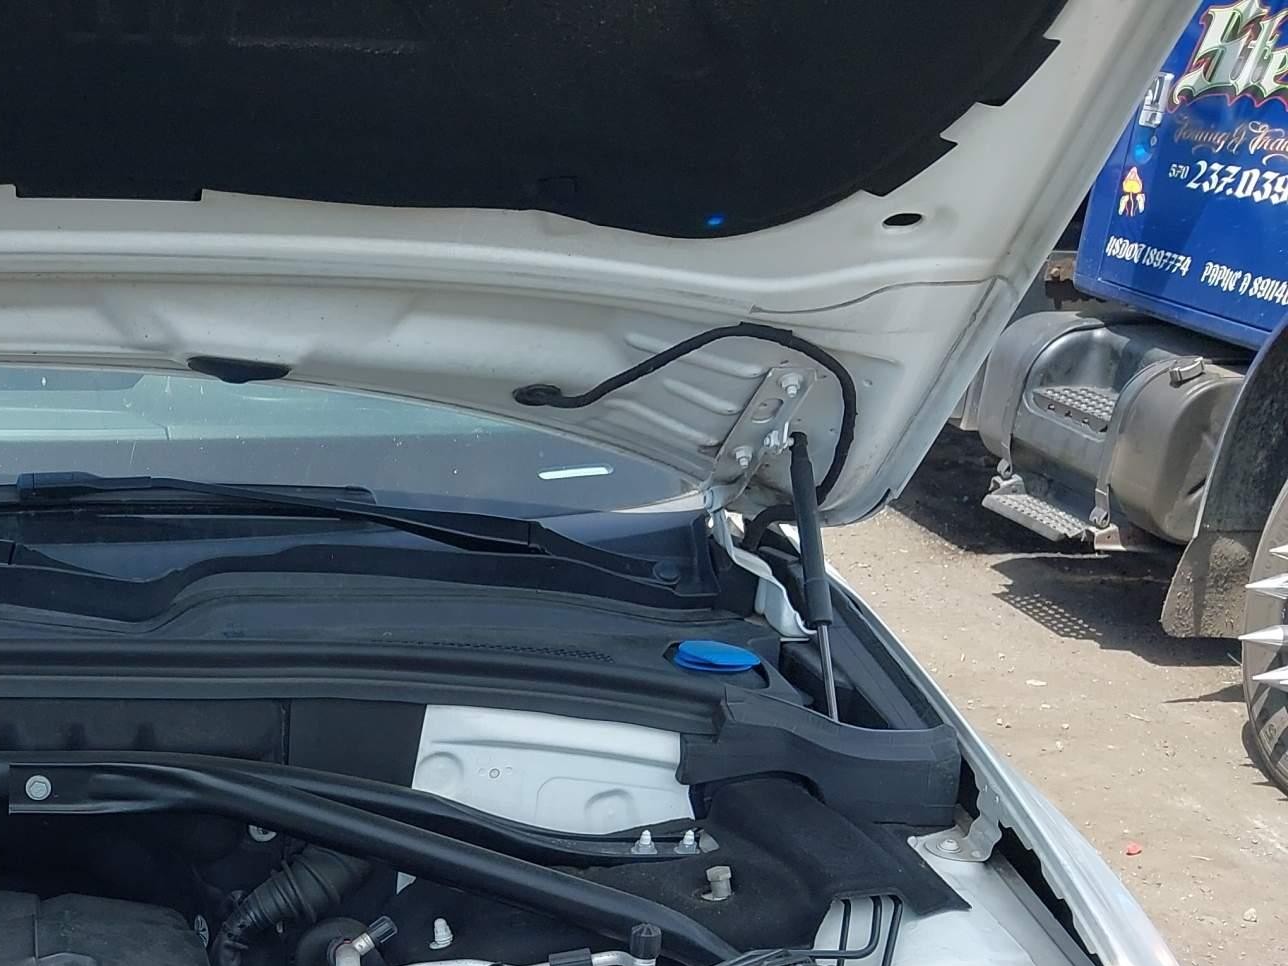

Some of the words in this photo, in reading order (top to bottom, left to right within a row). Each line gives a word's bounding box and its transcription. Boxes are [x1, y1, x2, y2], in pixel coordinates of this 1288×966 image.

[1168, 163, 1190, 179] 570
[1105, 235, 1146, 264] USDOT
[1141, 246, 1192, 277] 1897774
